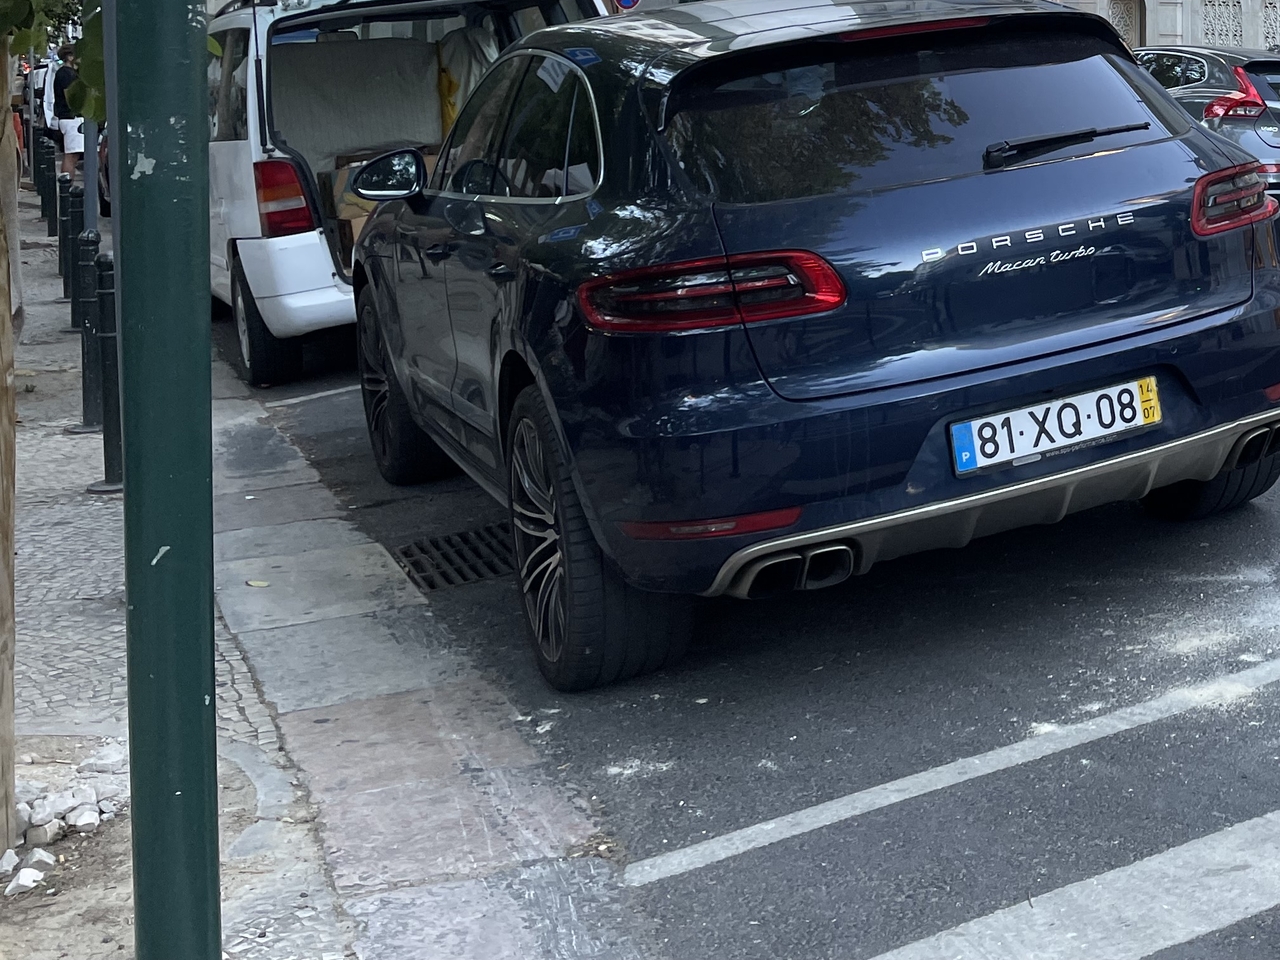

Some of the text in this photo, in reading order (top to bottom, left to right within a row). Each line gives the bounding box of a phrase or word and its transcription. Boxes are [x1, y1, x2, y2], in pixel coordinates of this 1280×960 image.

[921, 212, 1136, 263] PORSCHE
[978, 245, 1097, 277] Macan turbo
[1139, 382, 1153, 396] 14
[1143, 405, 1157, 419] 07
[961, 451, 971, 463] P
